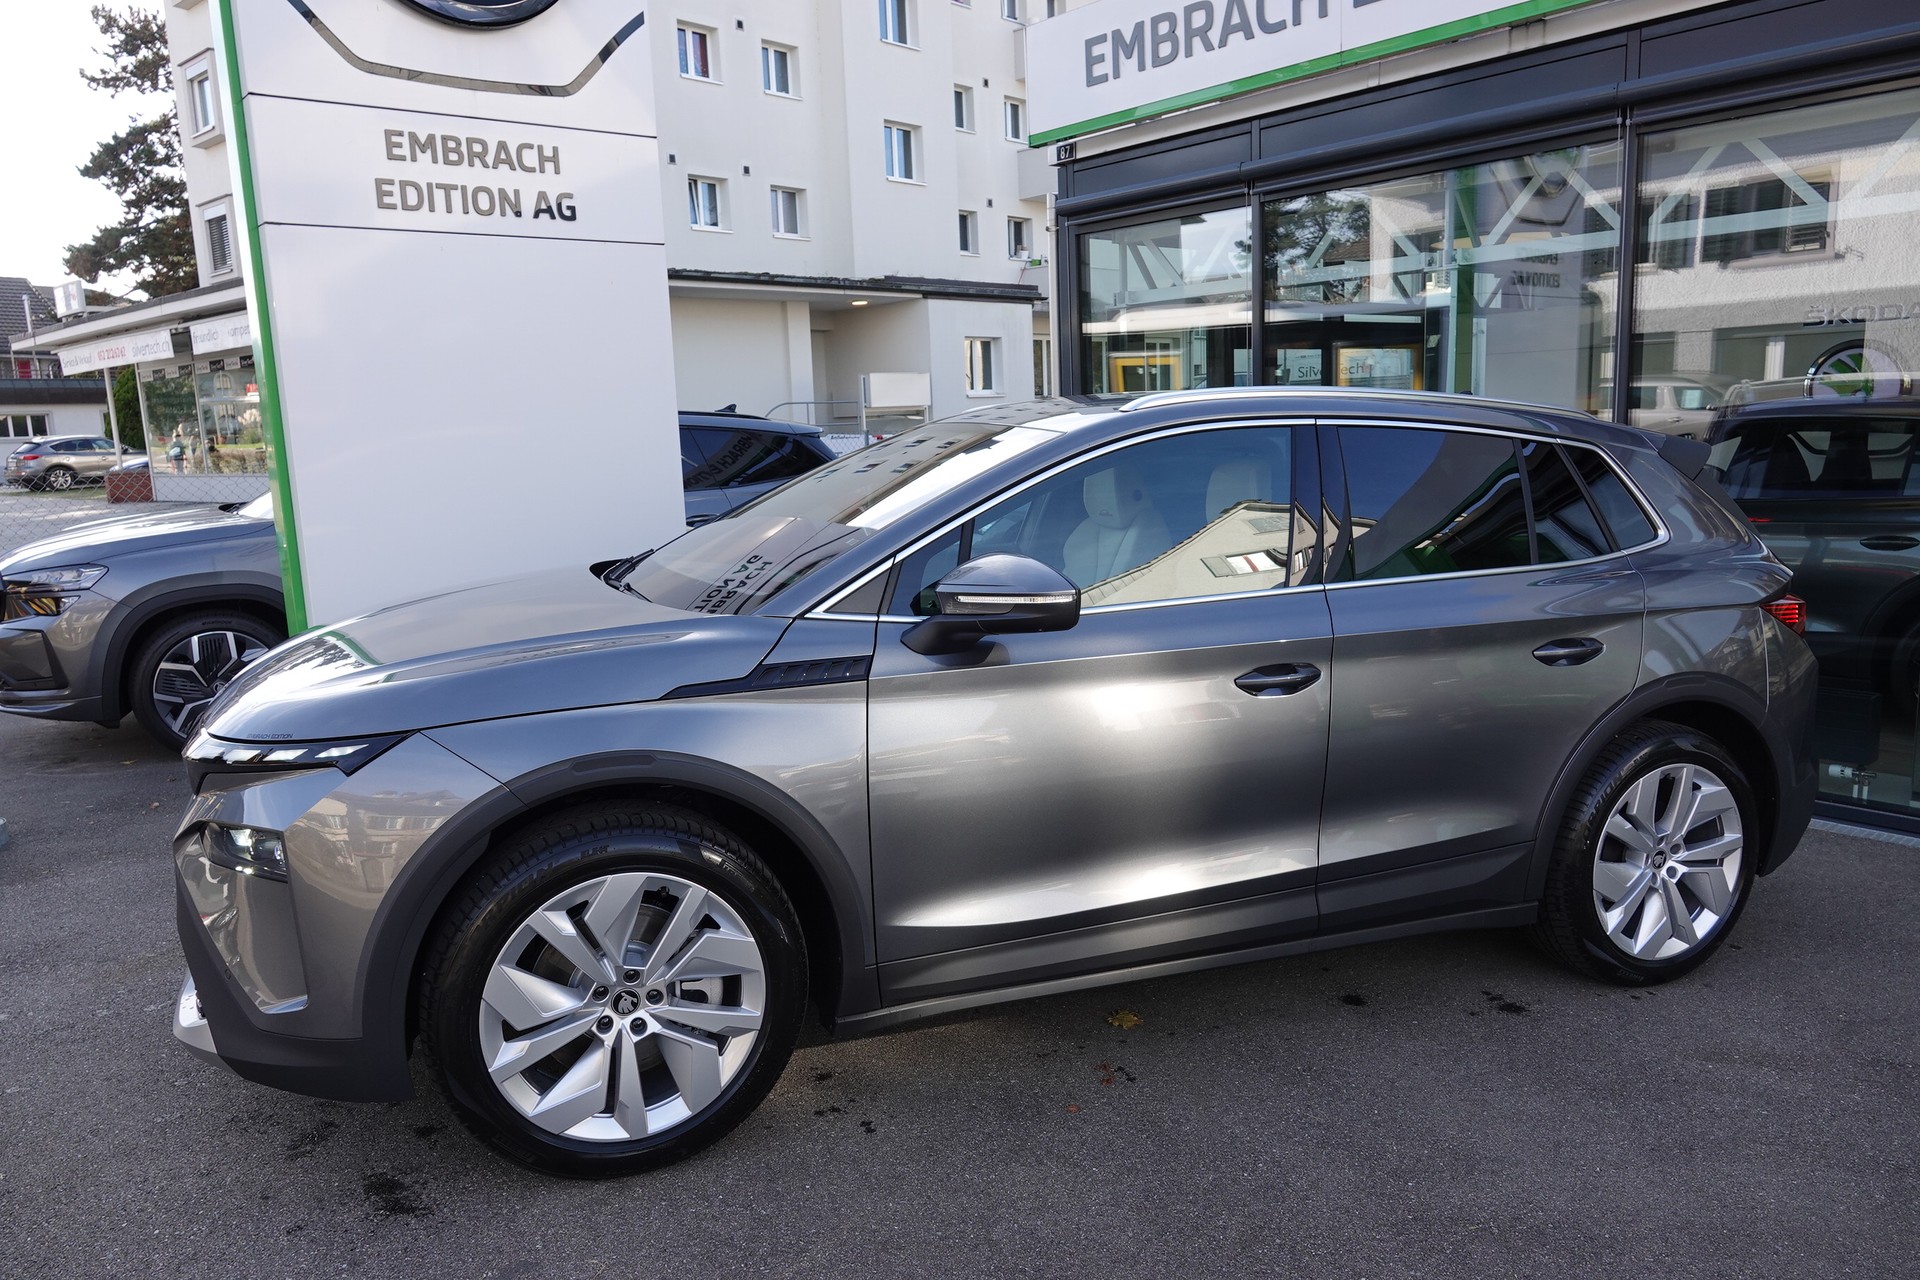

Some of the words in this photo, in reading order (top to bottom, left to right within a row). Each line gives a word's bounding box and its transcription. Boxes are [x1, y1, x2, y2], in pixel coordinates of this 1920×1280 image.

[384, 128, 561, 175] EMBRACH
[1060, 146, 1070, 160] 87
[374, 177, 522, 218] EDITION
[532, 190, 577, 222] AG
